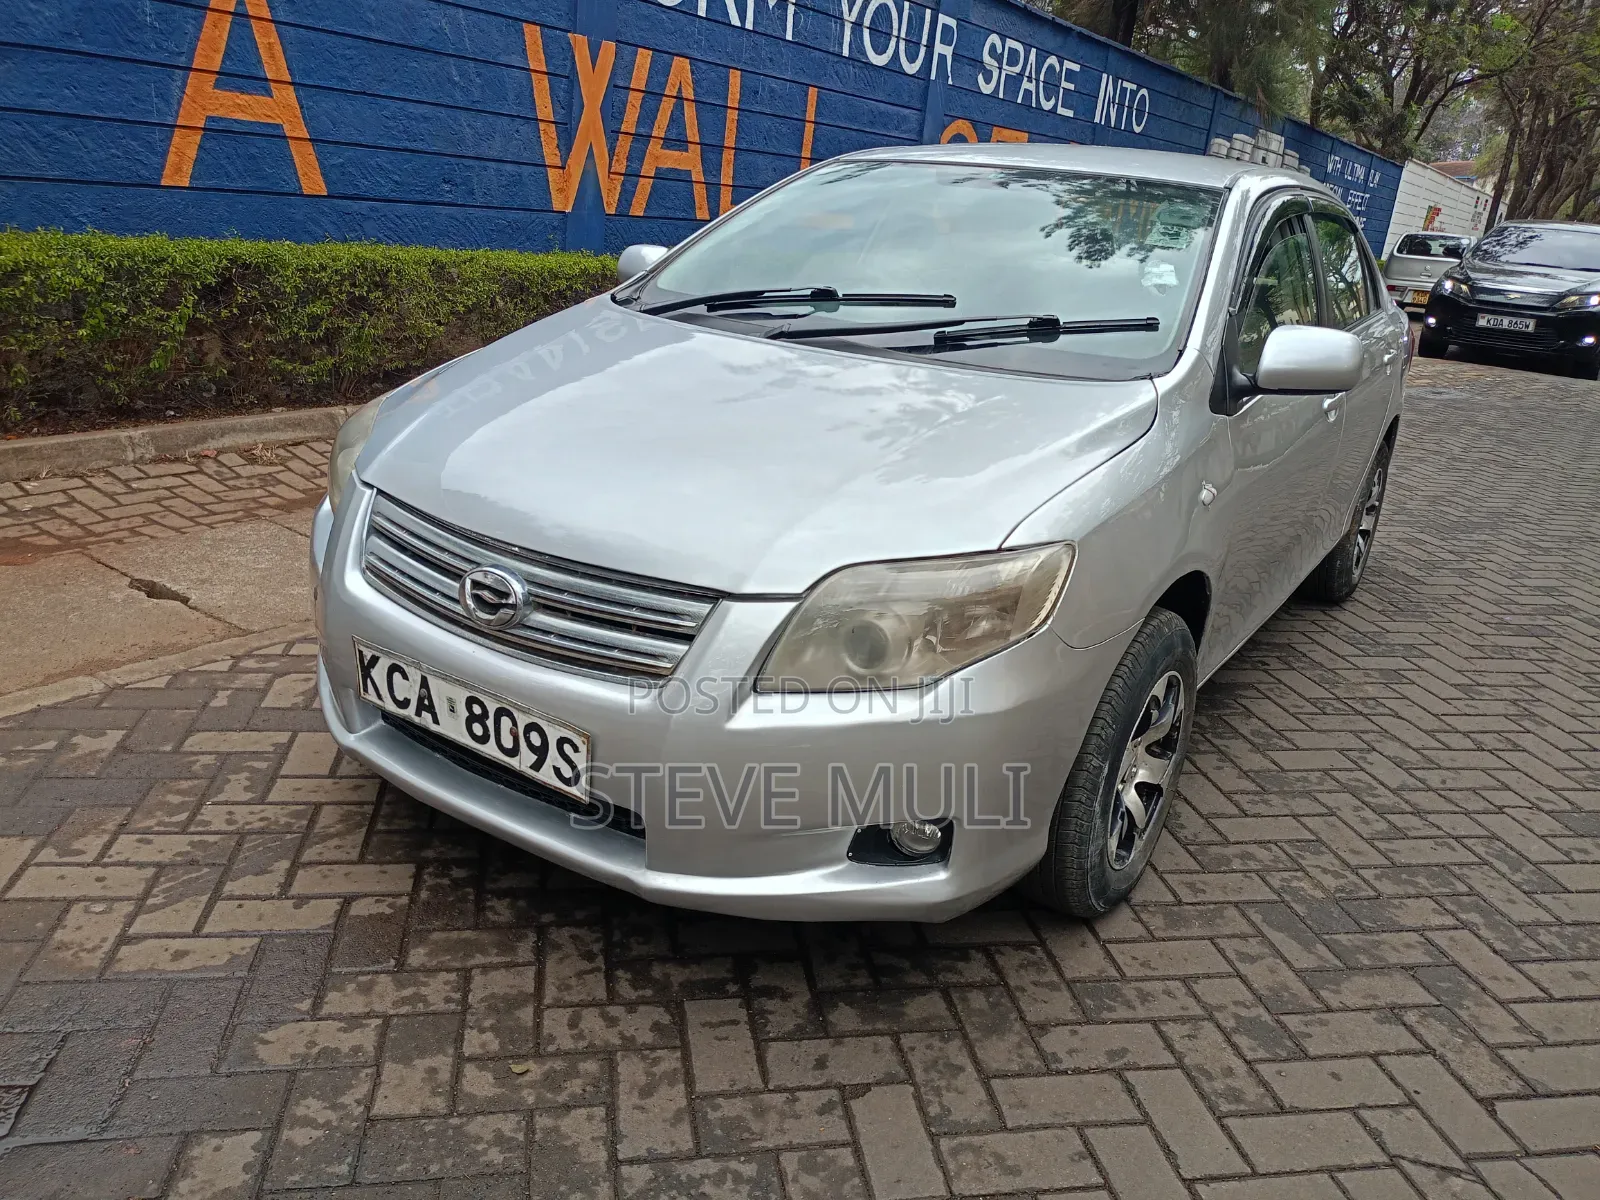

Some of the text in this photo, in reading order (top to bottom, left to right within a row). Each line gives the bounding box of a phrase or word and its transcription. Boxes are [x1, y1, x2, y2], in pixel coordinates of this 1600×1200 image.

[161, 0, 328, 195] A
[842, 0, 957, 84] YOUR
[977, 33, 1081, 117] SPACE
[1094, 73, 1149, 133] INTO
[1486, 317, 1531, 330] KDA 865W
[358, 650, 582, 788] KCA 809S
